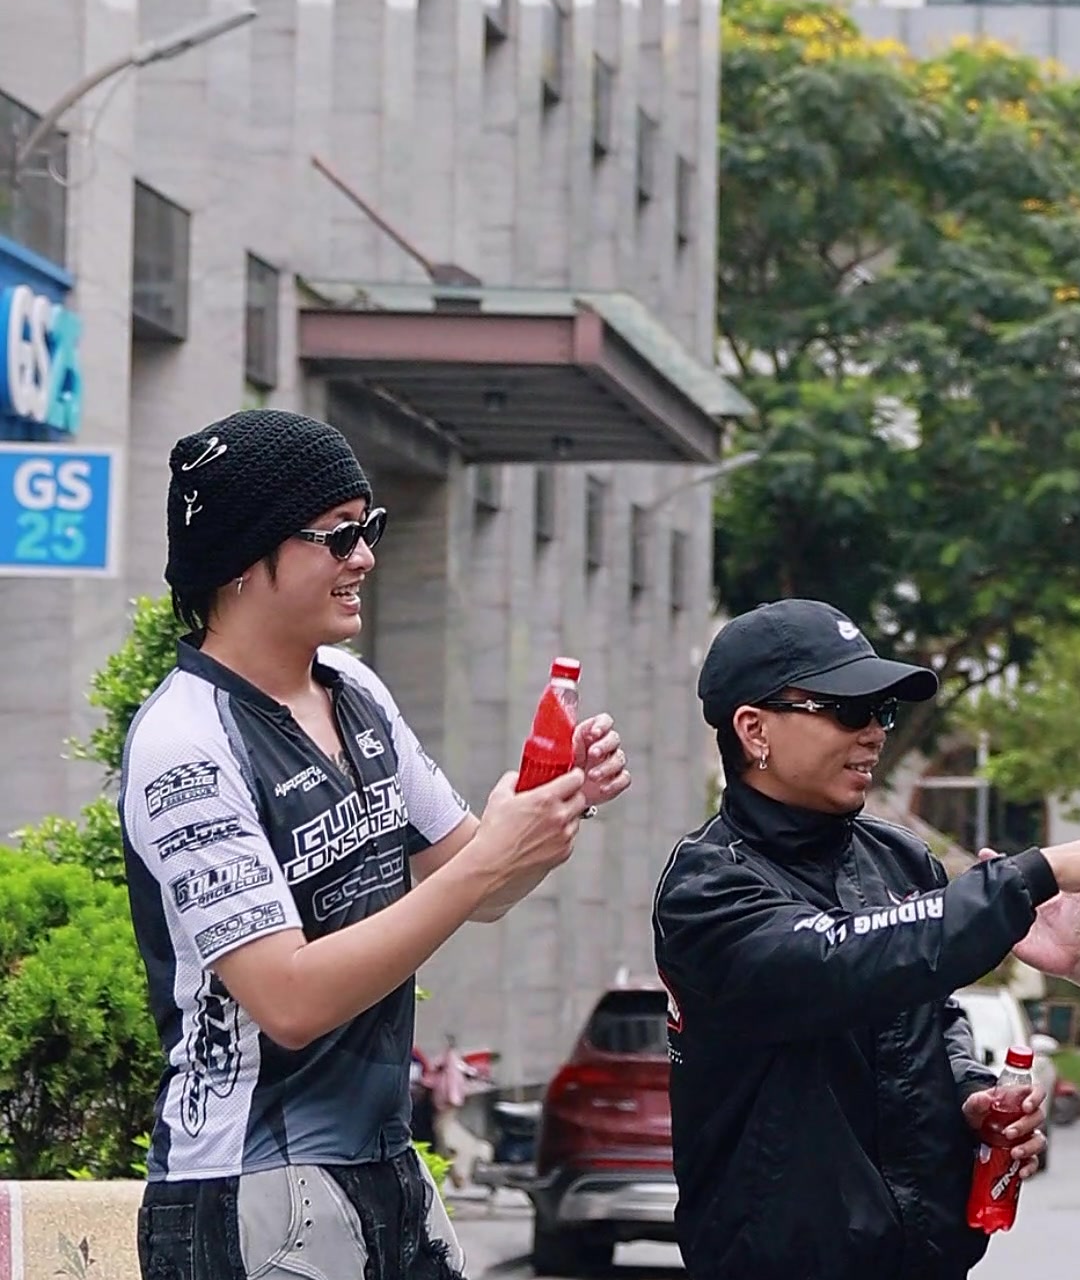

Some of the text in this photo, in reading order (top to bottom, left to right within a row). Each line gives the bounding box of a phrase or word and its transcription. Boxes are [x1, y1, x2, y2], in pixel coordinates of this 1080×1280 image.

[13, 458, 92, 510] GS
[15, 512, 86, 561] 25
[148, 775, 215, 815] GOLDIE
[173, 858, 263, 907] GOLDIE
[235, 872, 268, 890] CLUB
[214, 904, 279, 937] GOLDIE
[853, 896, 943, 935] RIDING
